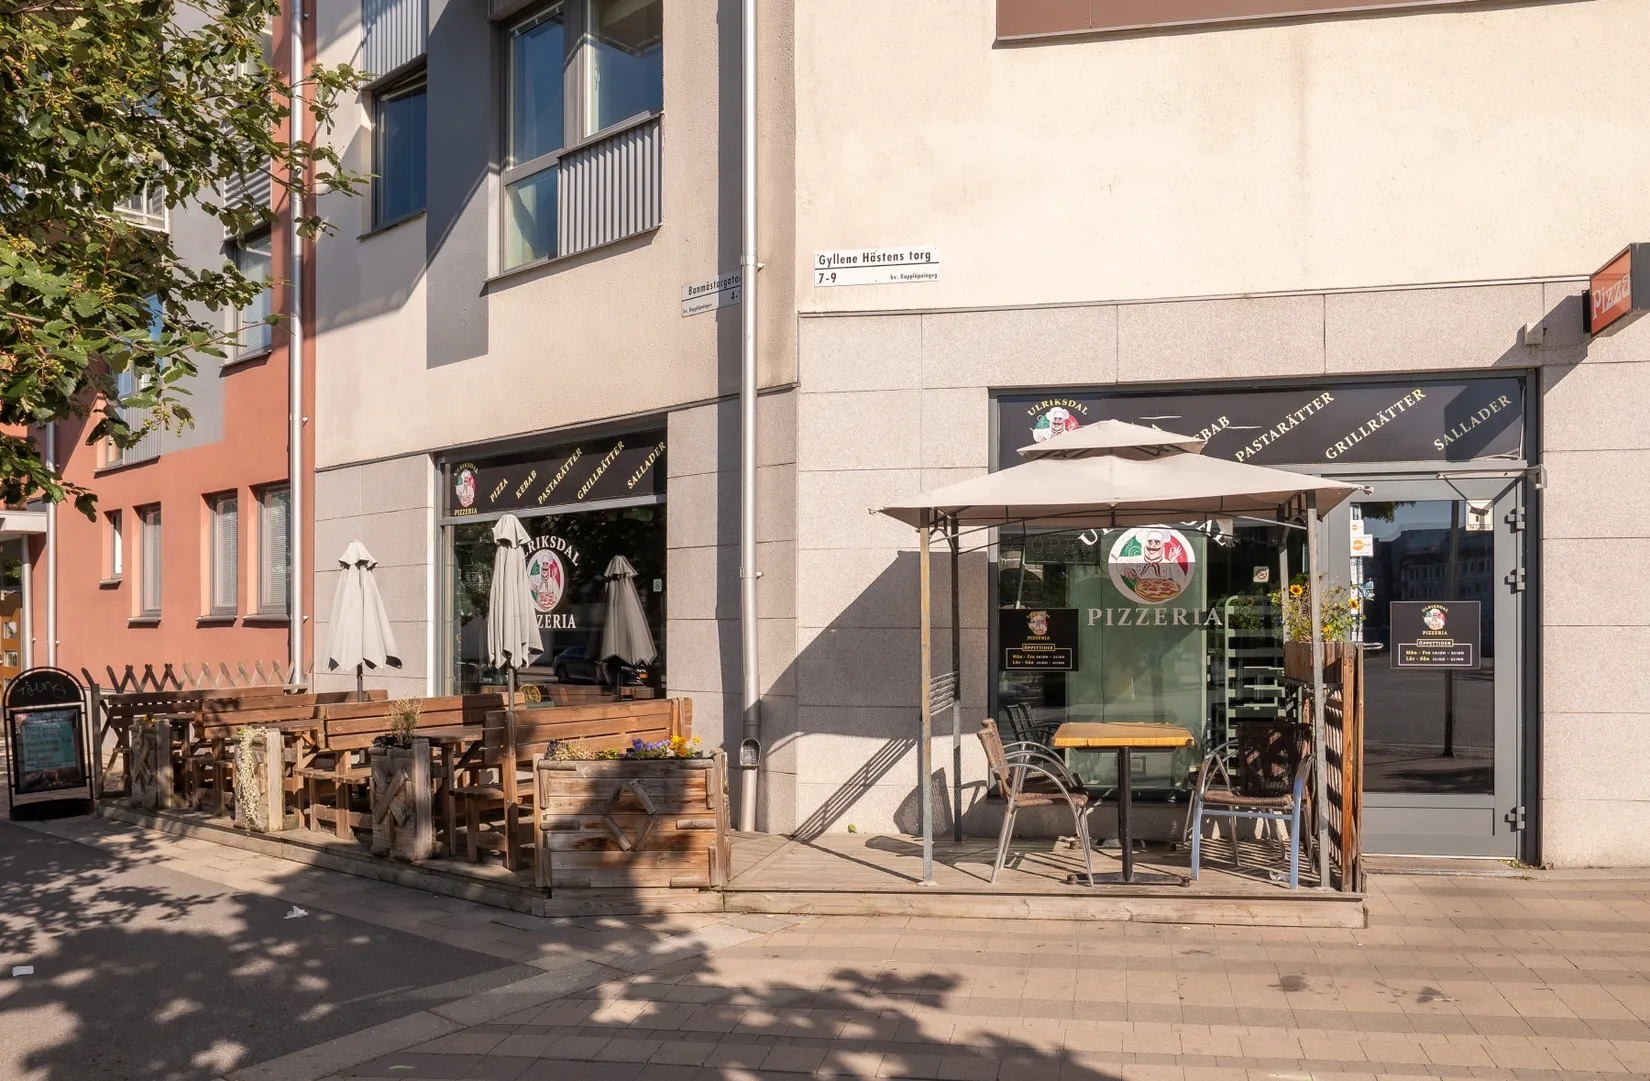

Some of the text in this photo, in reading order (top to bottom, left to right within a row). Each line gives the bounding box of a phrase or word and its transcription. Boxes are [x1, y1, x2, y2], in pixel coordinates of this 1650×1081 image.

[819, 251, 931, 268] Gyllene Hästens torg
[818, 272, 836, 284] 7-9
[731, 290, 741, 301] 4-
[1592, 273, 1630, 320] Pizza
[1026, 398, 1088, 416] ULRIKSDAL
[1193, 416, 1230, 440] BAB
[1234, 391, 1334, 462] PASTARÄTTER
[1325, 388, 1426, 460] GRILLRÄTTER
[1433, 394, 1512, 450] SALLADER
[454, 462, 479, 476] ULRIKSDAL
[538, 448, 583, 505] PASTARÄTTER
[577, 441, 625, 500] GRILLRÄTTER
[627, 441, 666, 489] SALLADER
[490, 478, 508, 502] PIZZA
[516, 470, 537, 499] KEBAB
[524, 535, 580, 566] RIKSDAL
[536, 614, 577, 628] ZERIA
[1087, 607, 1223, 626] PIZZERIA
